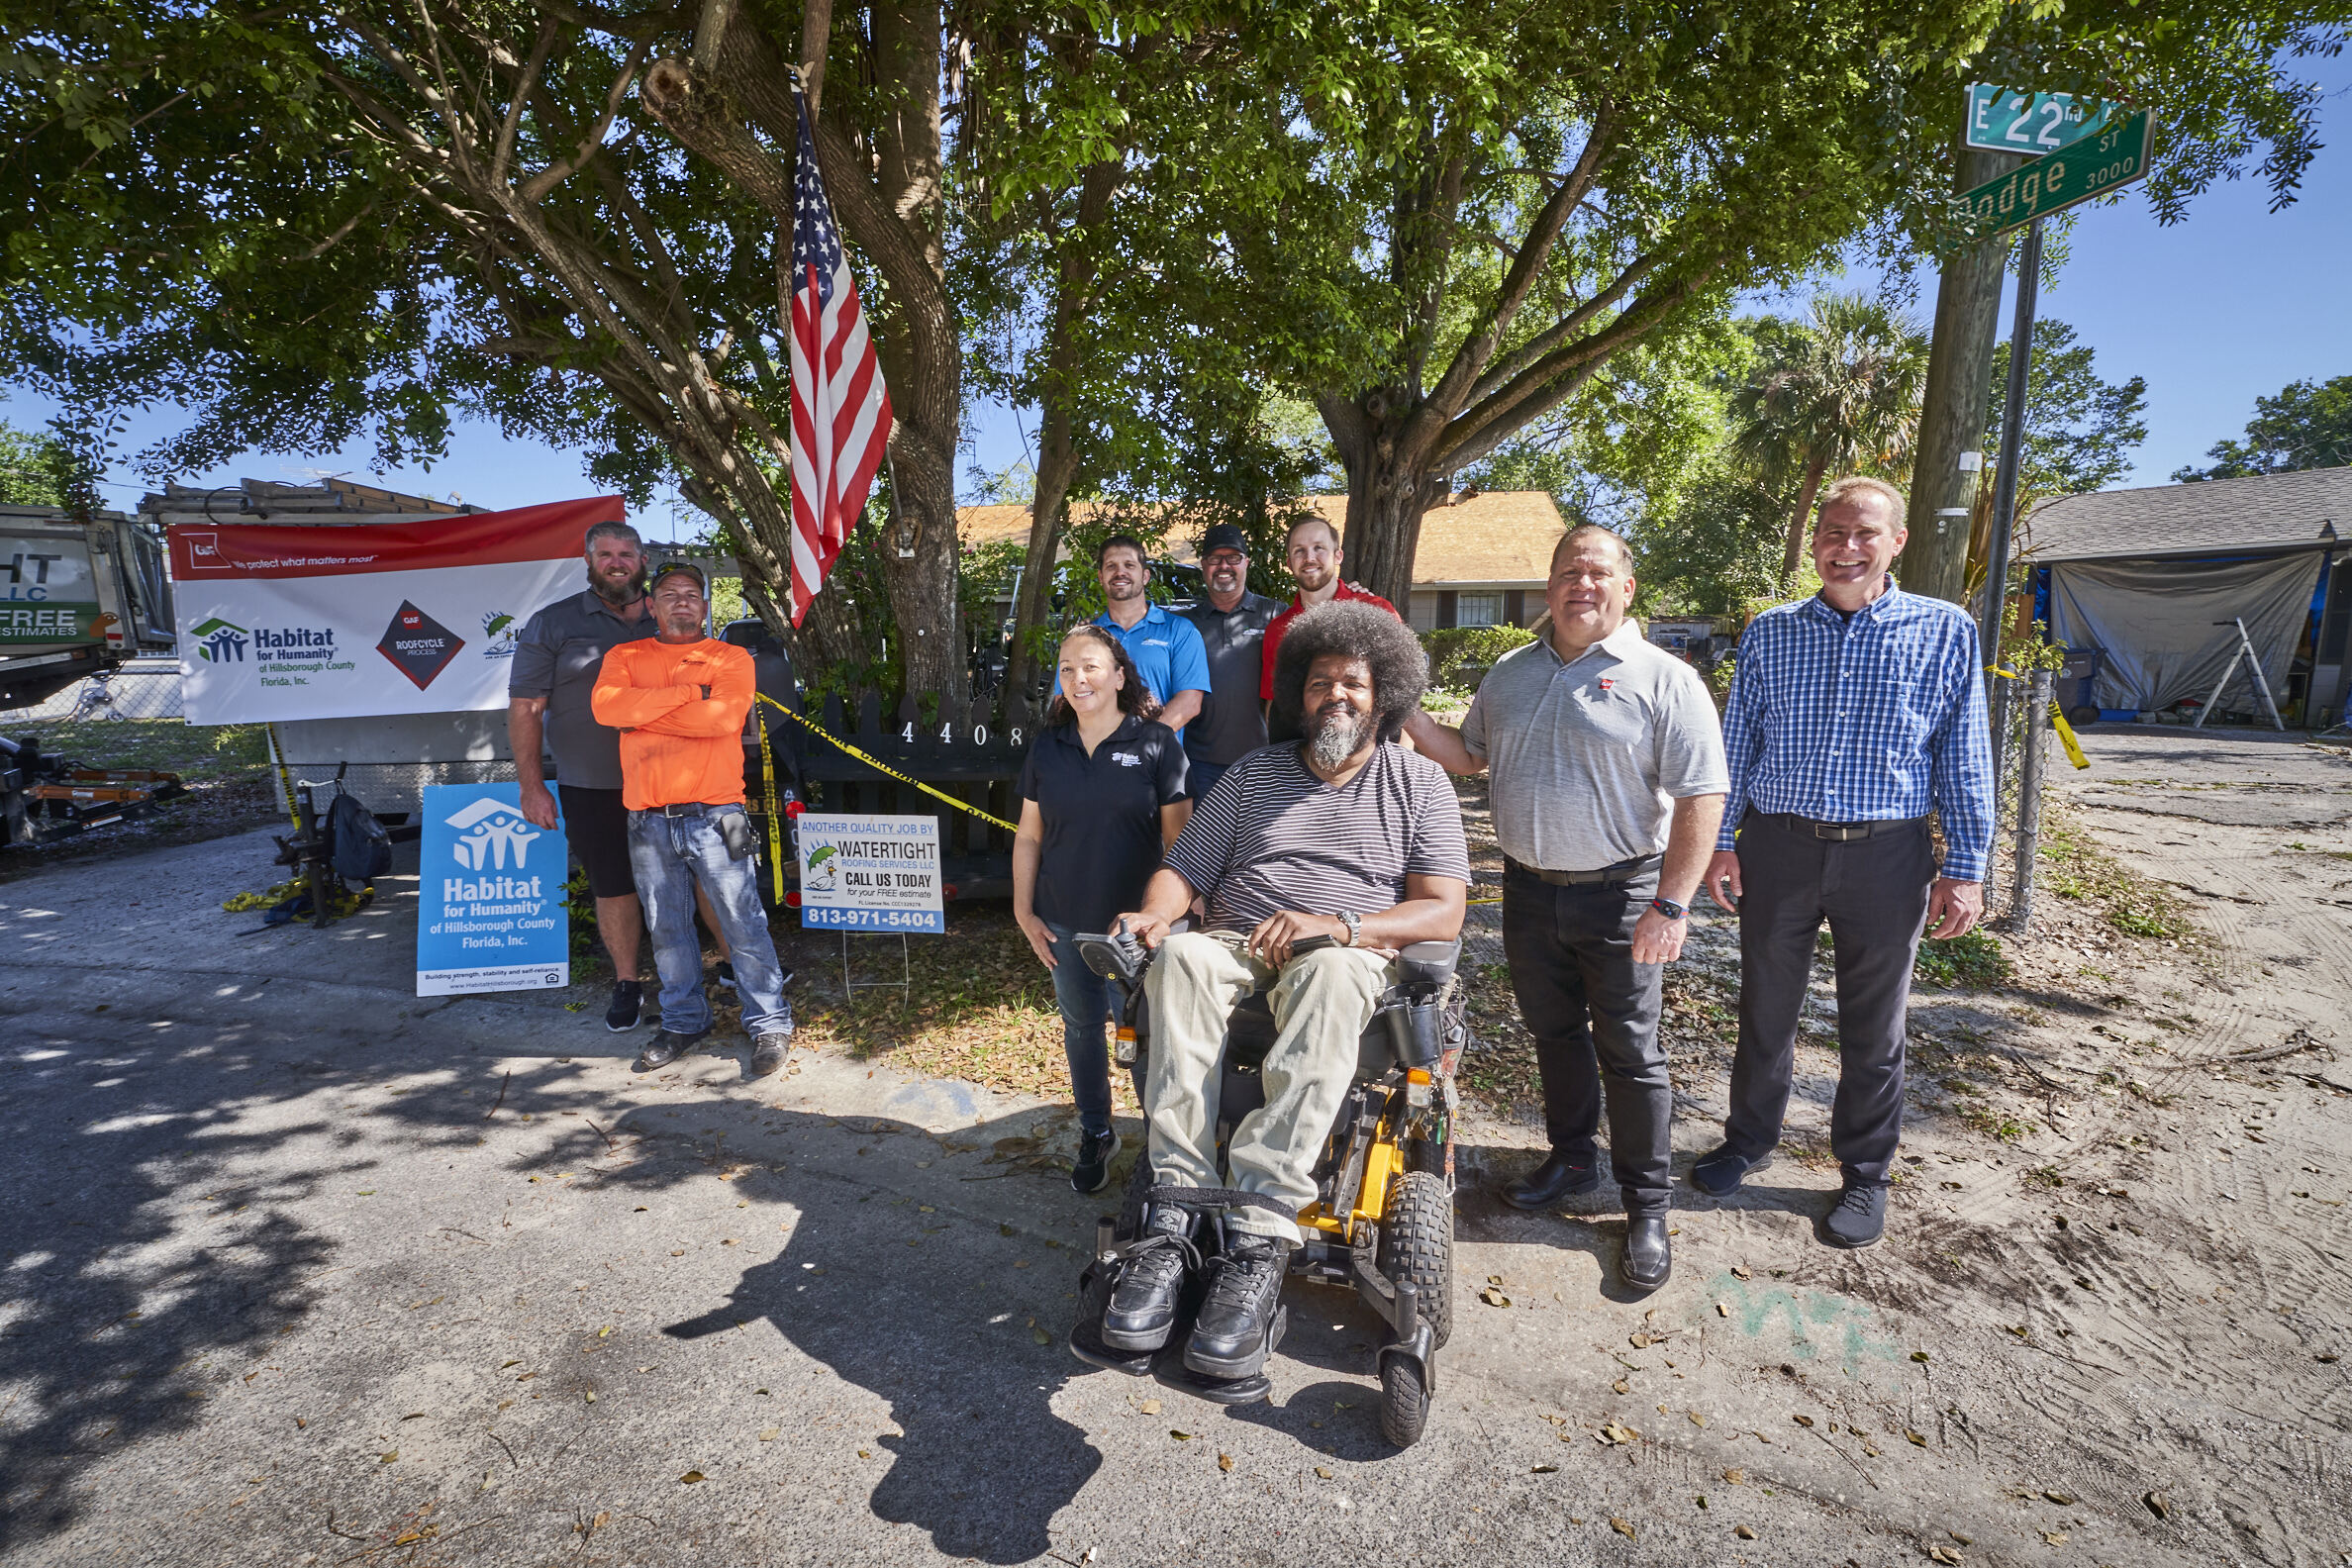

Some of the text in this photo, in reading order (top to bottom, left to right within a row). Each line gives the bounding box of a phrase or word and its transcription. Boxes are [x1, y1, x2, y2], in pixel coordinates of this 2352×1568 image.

[1976, 99, 1991, 129] E
[2099, 130, 2120, 152] ST
[2086, 156, 2134, 189] 3000
[246, 559, 279, 570] protect
[281, 557, 306, 566] what
[307, 557, 346, 566] matters
[0, 587, 48, 601] LC
[0, 627, 77, 637] STIMATES
[254, 628, 334, 648] Habitat
[396, 638, 445, 650] ROOFCYCLE
[256, 649, 273, 660] for
[259, 661, 355, 673] of Hillsborough County
[261, 676, 309, 687] Florida, Inc.
[802, 822, 934, 833] ANOTHER QUALITY JOB BY
[837, 840, 935, 859] WATERTIGHT
[841, 859, 877, 868] ROOFING
[879, 860, 918, 869] SERVICES
[845, 872, 931, 888] CALL US TODAY
[443, 876, 541, 902] Habitat
[858, 889, 875, 898] your
[899, 890, 931, 899] estimate
[443, 904, 465, 918] for
[808, 908, 936, 927] 813-971-5404
[430, 918, 555, 933] of Hillsborough County
[462, 935, 528, 948] Florida, Inc.
